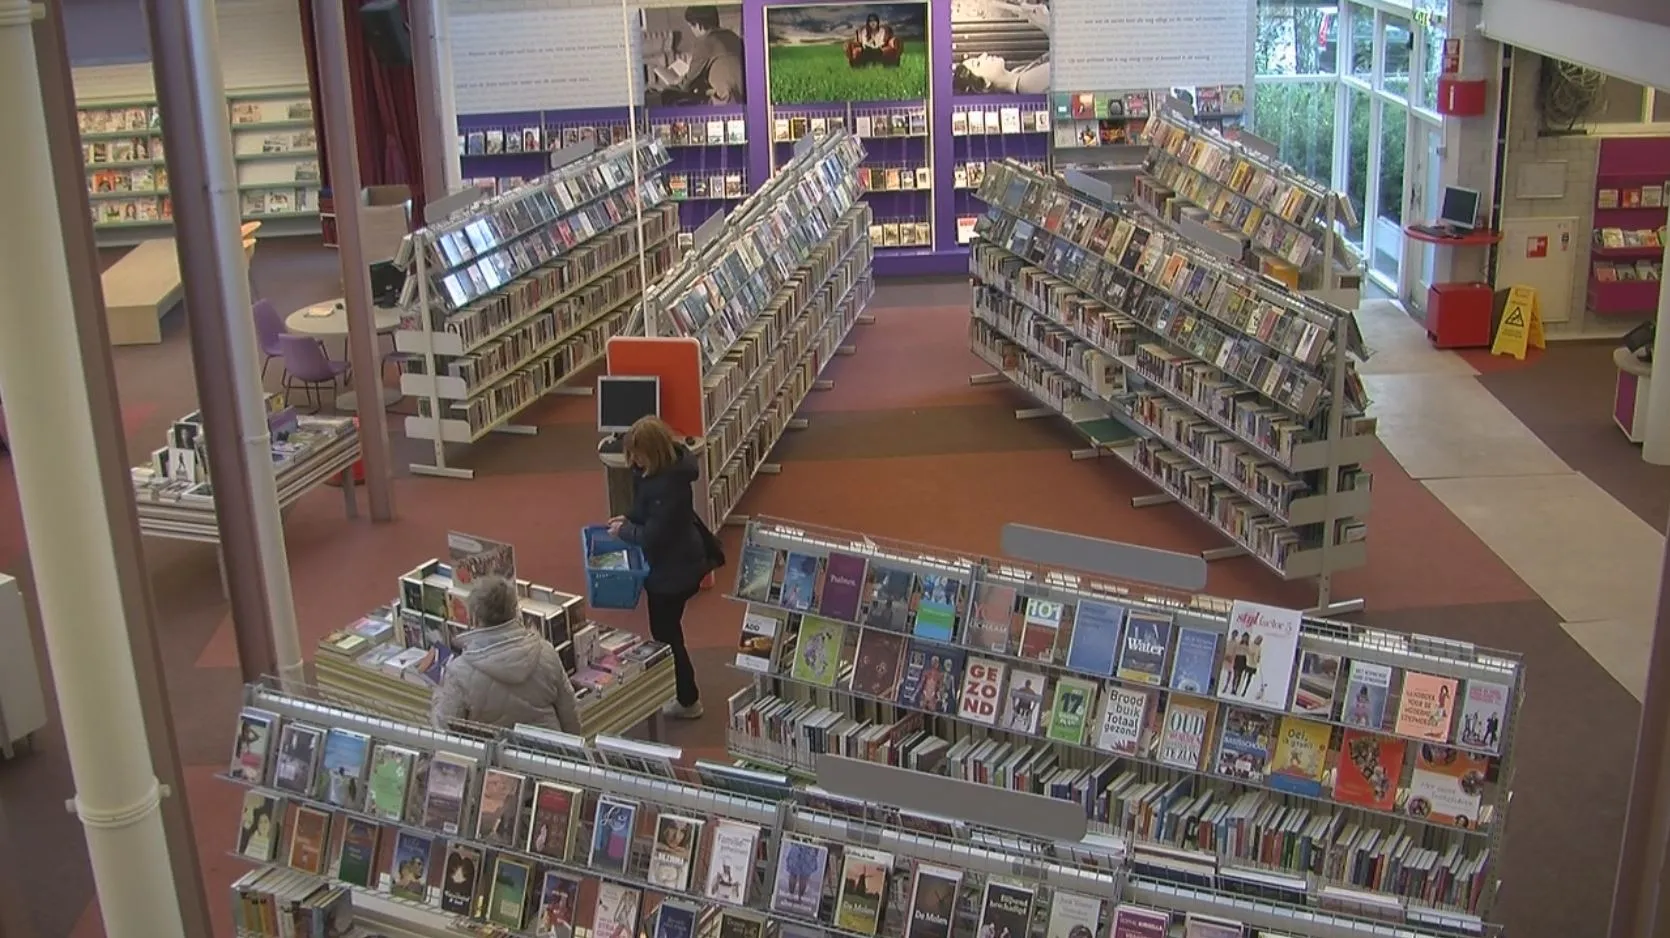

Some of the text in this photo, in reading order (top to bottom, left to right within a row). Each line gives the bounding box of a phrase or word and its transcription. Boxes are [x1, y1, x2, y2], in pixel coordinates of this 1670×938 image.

[1029, 600, 1062, 621] 101
[1128, 637, 1165, 657] Water
[969, 664, 998, 682] GE
[966, 681, 997, 699] ZO
[1110, 689, 1144, 707] Brood
[963, 698, 994, 716] ND
[1062, 692, 1084, 714] 17
[1116, 703, 1141, 718] buik
[1107, 711, 1139, 728] Totaal
[1171, 711, 1204, 736] OUD
[1103, 722, 1138, 738] gezond
[915, 910, 948, 926] De Molen
